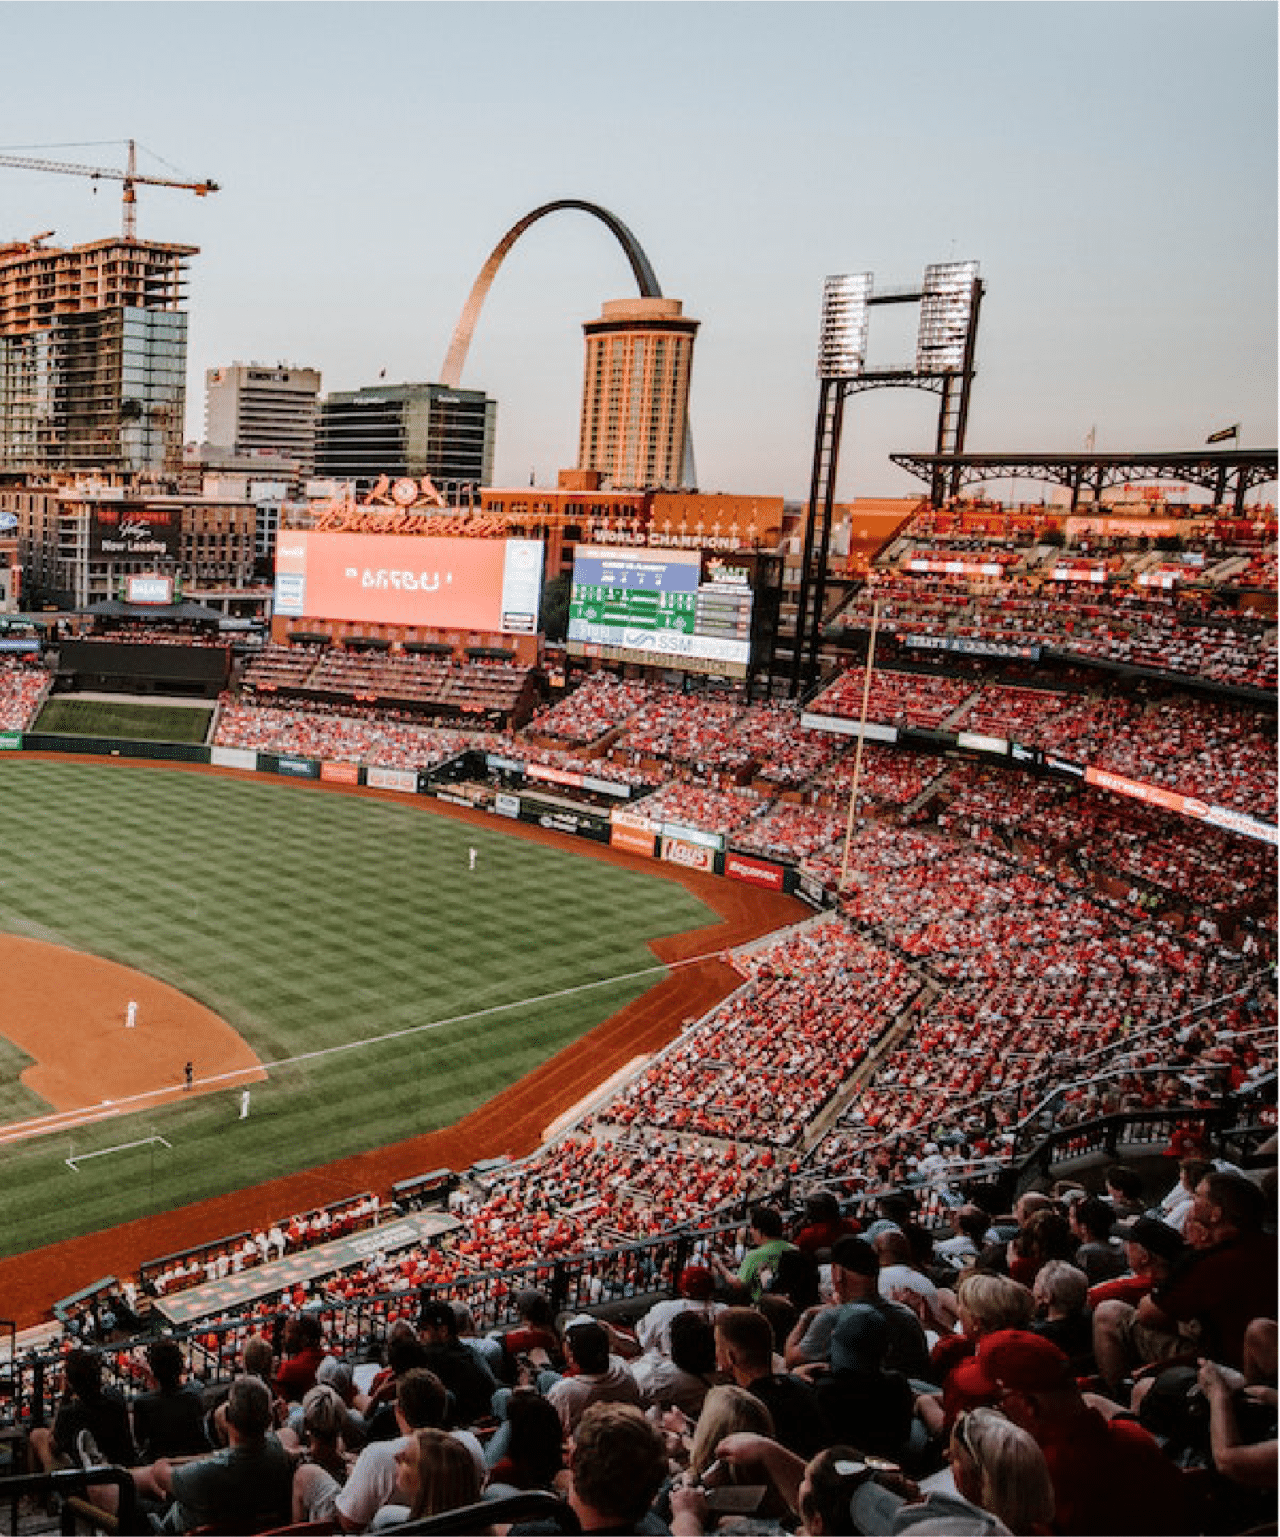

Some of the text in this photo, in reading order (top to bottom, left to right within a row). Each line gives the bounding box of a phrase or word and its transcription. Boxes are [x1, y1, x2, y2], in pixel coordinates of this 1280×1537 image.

[308, 498, 507, 538] Budweiser
[127, 539, 167, 555] Leasing
[594, 530, 741, 549] WORLD CHAMPIONS
[658, 636, 691, 653] SSM
